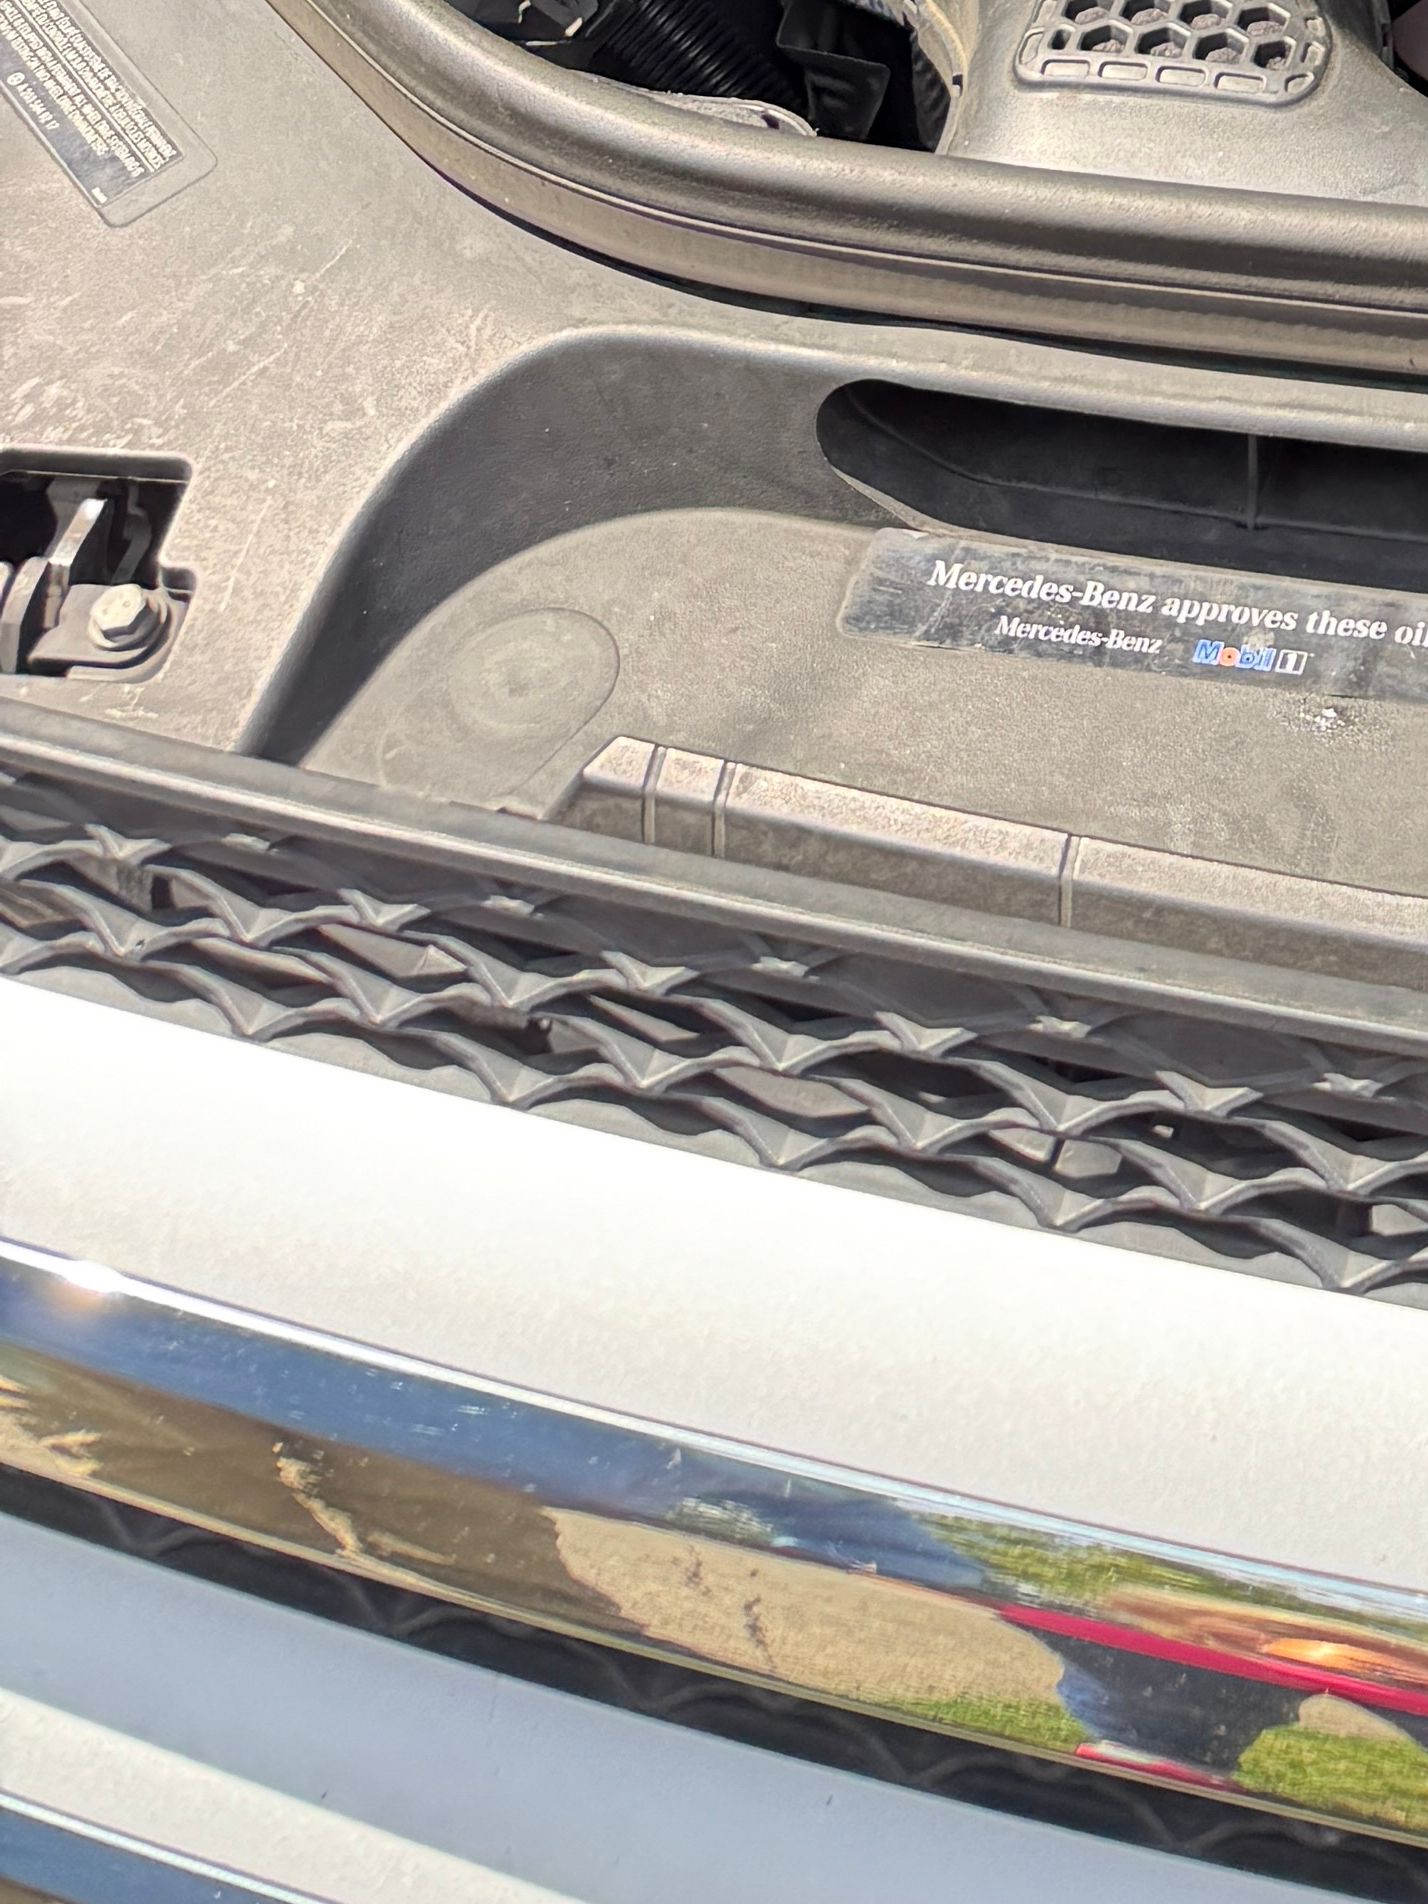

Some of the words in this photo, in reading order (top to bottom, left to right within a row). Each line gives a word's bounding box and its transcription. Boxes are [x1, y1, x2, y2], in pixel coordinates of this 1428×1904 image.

[927, 559, 1157, 614] Mercedes-Benz
[1160, 597, 1299, 631] approves
[1305, 610, 1388, 641] these
[994, 615, 1163, 654] Mercedes-Benz
[1192, 639, 1277, 672] Mobil
